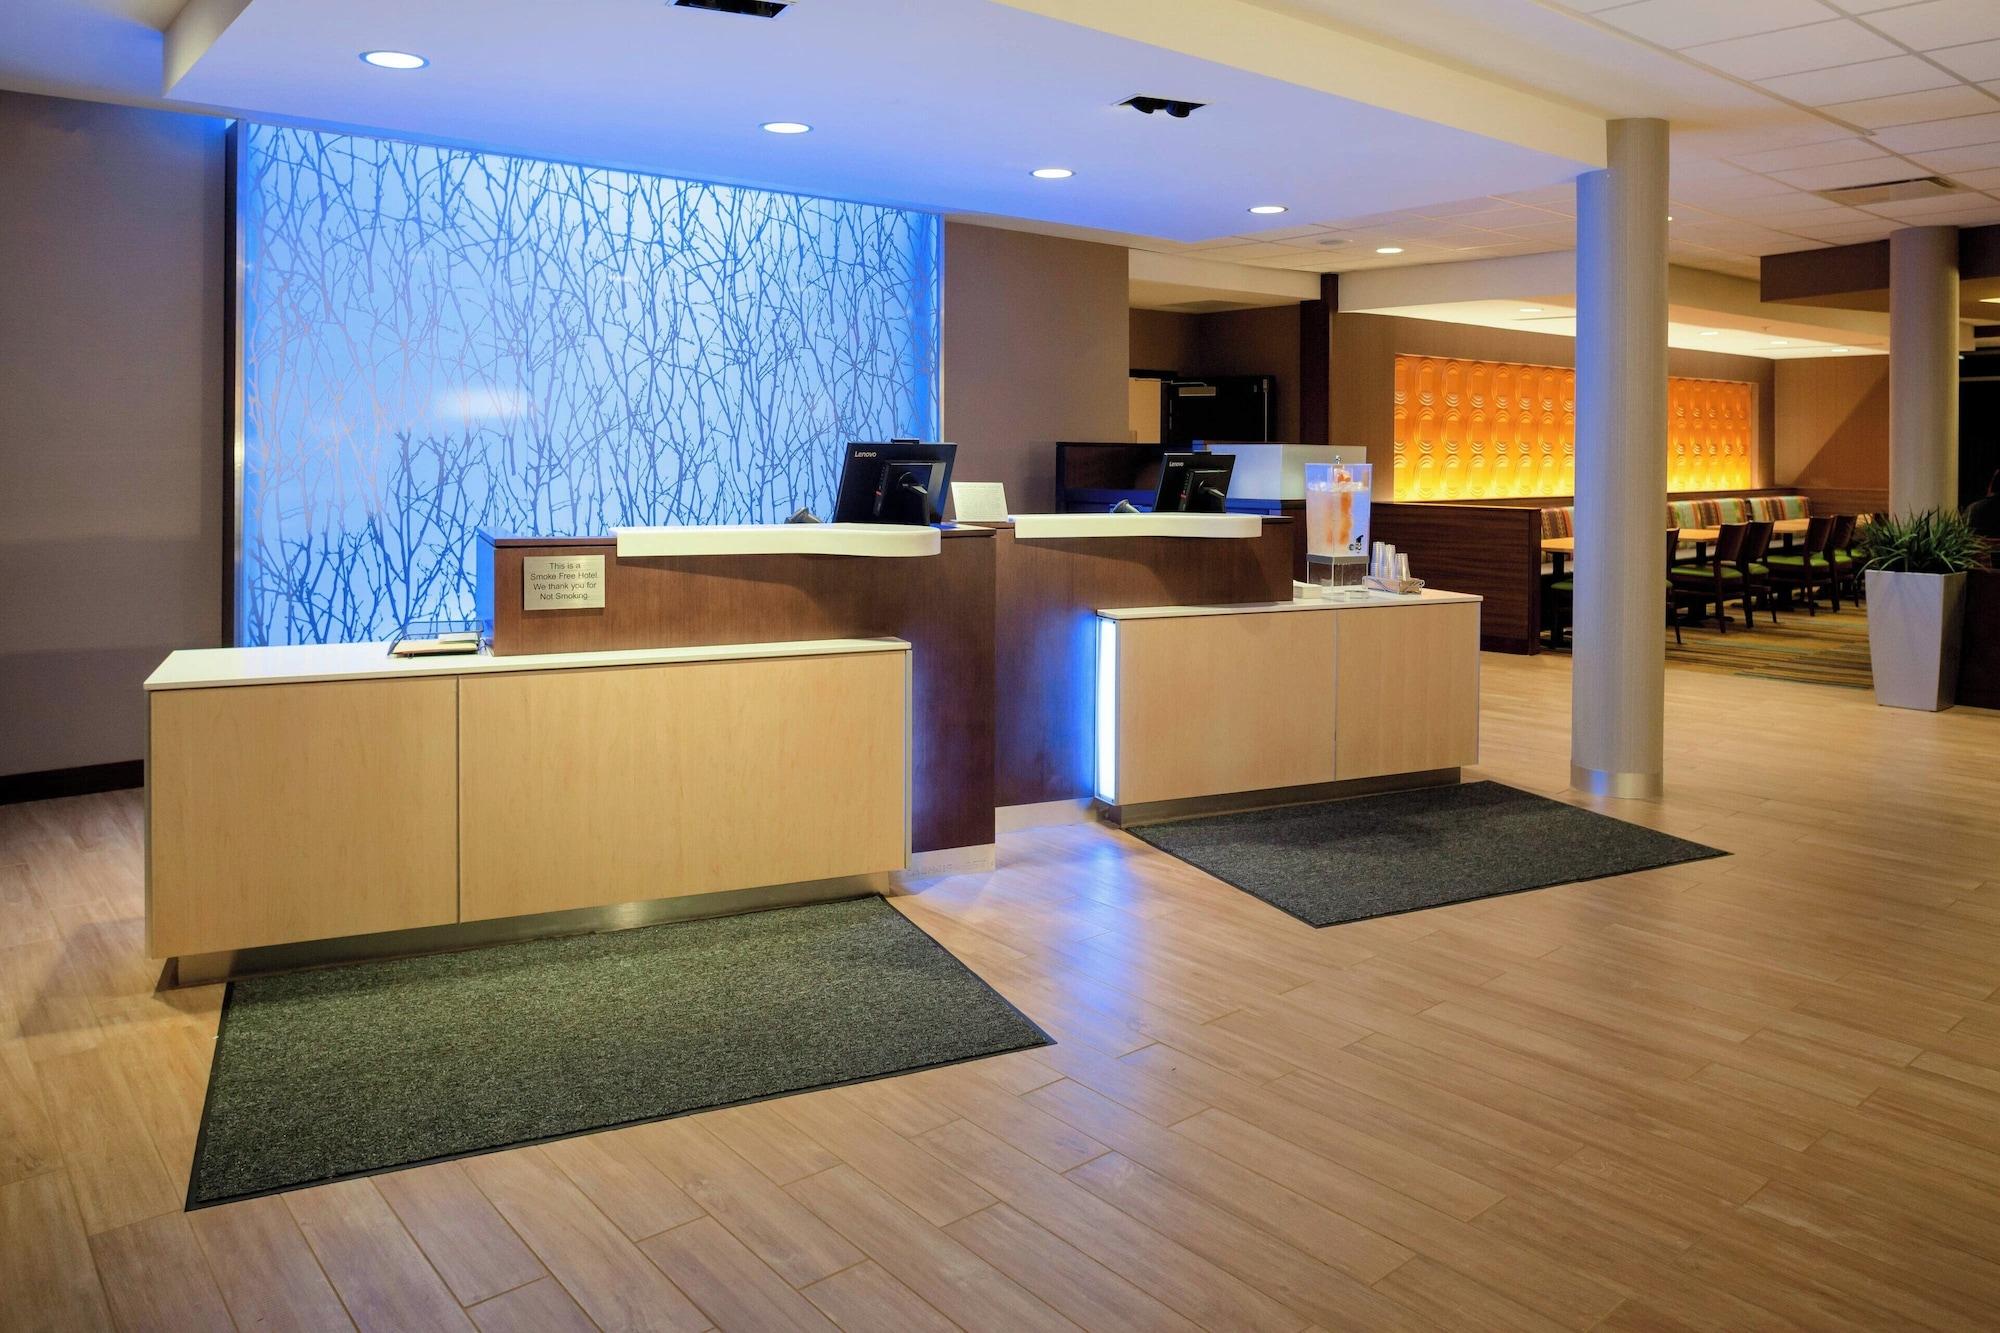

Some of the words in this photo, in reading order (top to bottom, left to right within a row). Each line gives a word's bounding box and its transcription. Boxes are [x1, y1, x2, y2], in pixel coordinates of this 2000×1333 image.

[854, 450, 877, 458] Lenovo
[530, 573, 556, 581] Smoke
[558, 572, 576, 580] Free
[533, 583, 546, 591] We
[548, 581, 569, 590] thank
[571, 583, 585, 591] you
[586, 581, 597, 589] for
